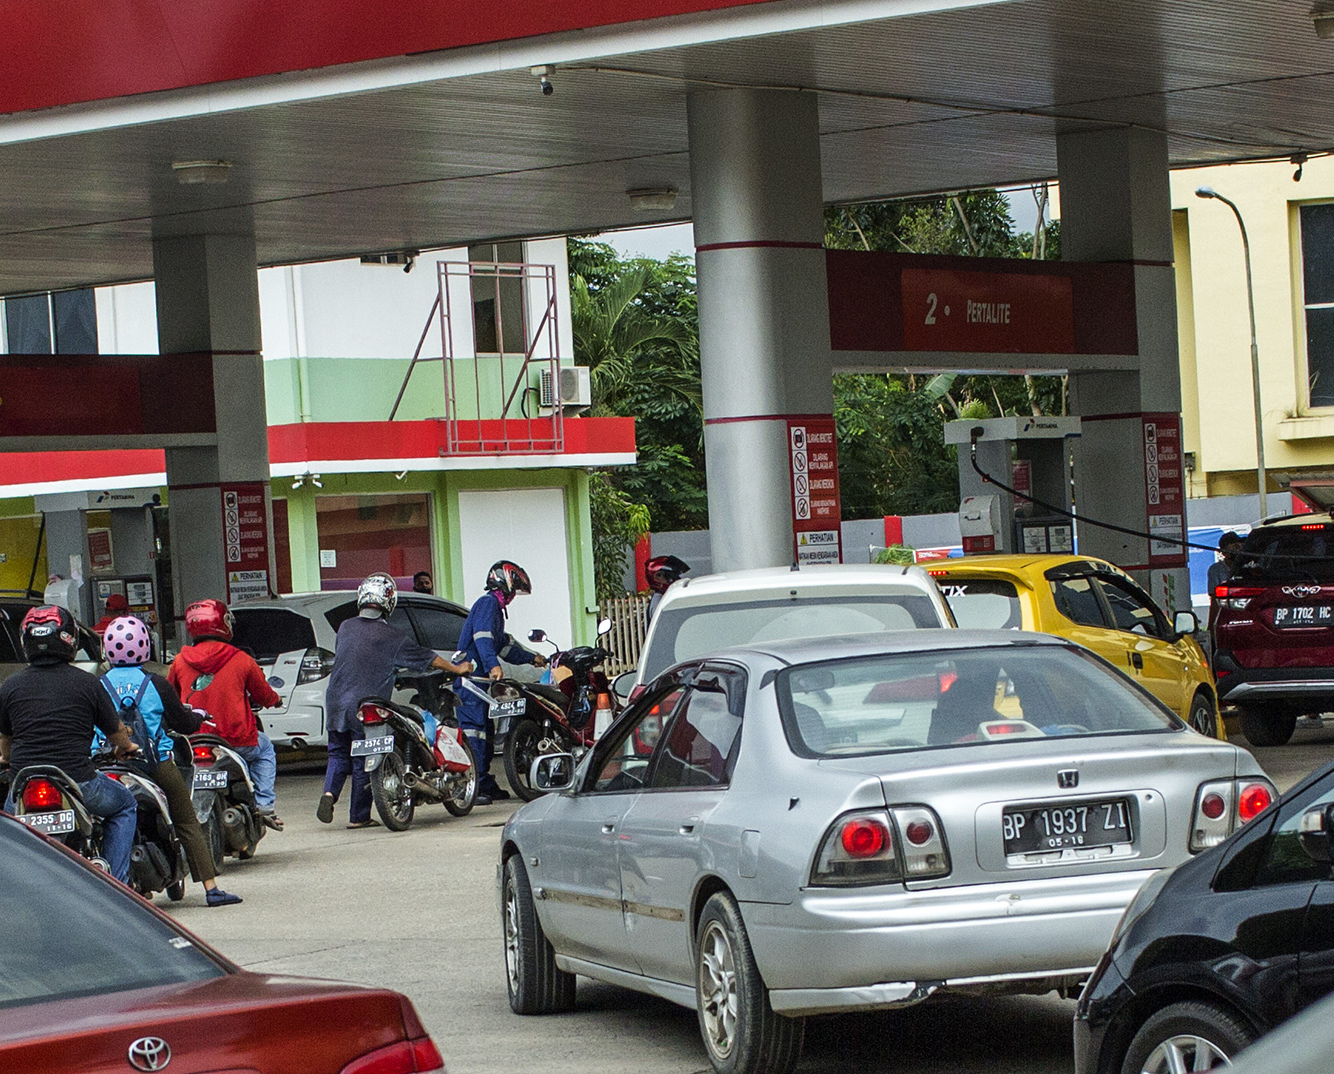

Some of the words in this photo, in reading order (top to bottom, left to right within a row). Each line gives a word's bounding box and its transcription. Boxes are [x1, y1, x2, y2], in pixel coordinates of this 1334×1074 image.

[967, 299, 1011, 324] PERTALITE
[1277, 608, 1288, 620] BP
[1293, 607, 1314, 619] 1702
[1319, 606, 1331, 618] HC
[30, 814, 54, 826] 2355
[59, 812, 72, 823] DG
[1004, 813, 1025, 840] BP
[1042, 806, 1088, 836] 1937
[1101, 802, 1126, 829] ZI
